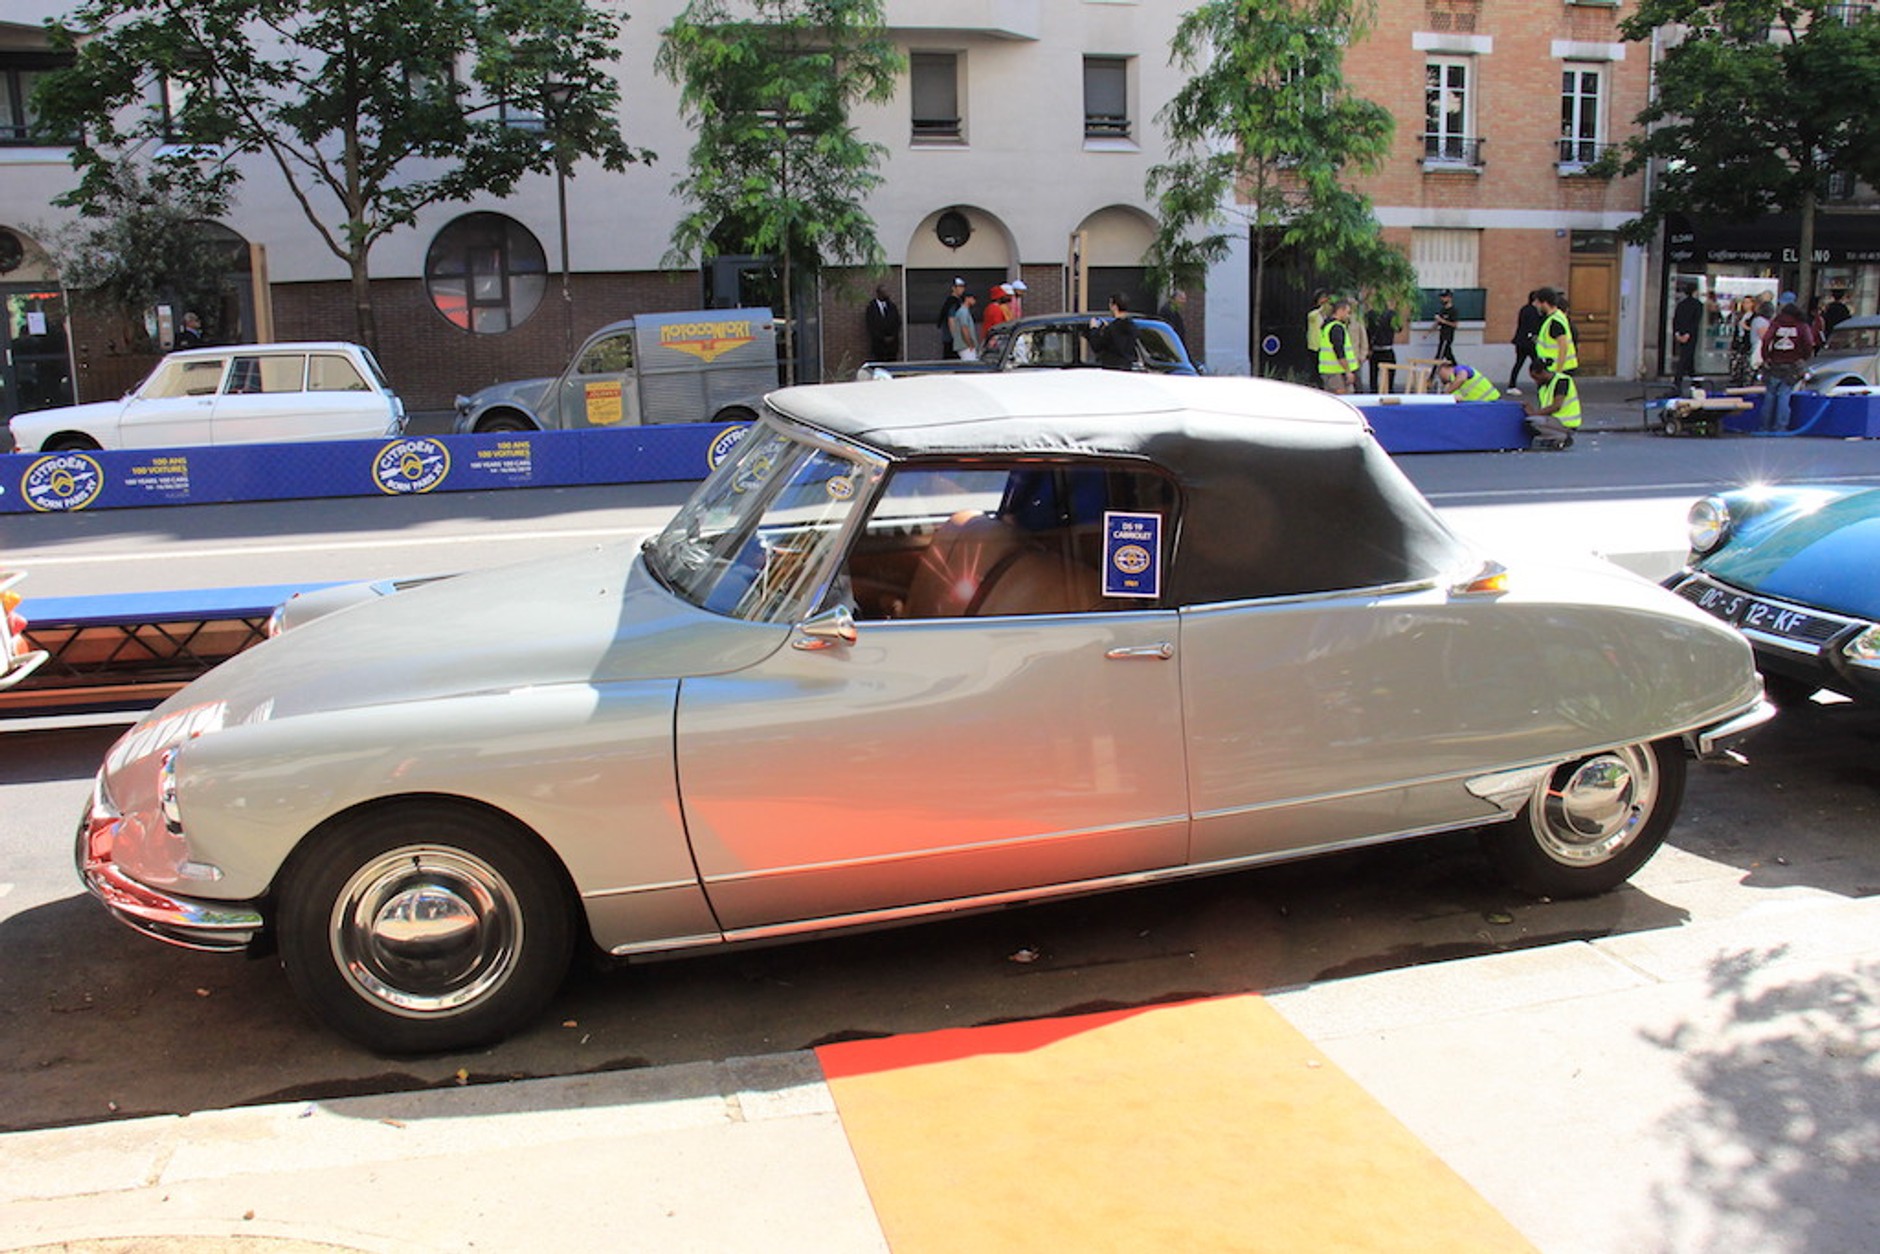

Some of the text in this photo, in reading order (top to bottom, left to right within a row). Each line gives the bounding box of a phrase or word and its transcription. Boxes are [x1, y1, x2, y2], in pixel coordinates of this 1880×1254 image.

[660, 321, 751, 342] MOTOCONFORT
[1122, 522, 1133, 530] DS
[1112, 530, 1153, 541] CABRIOLET
